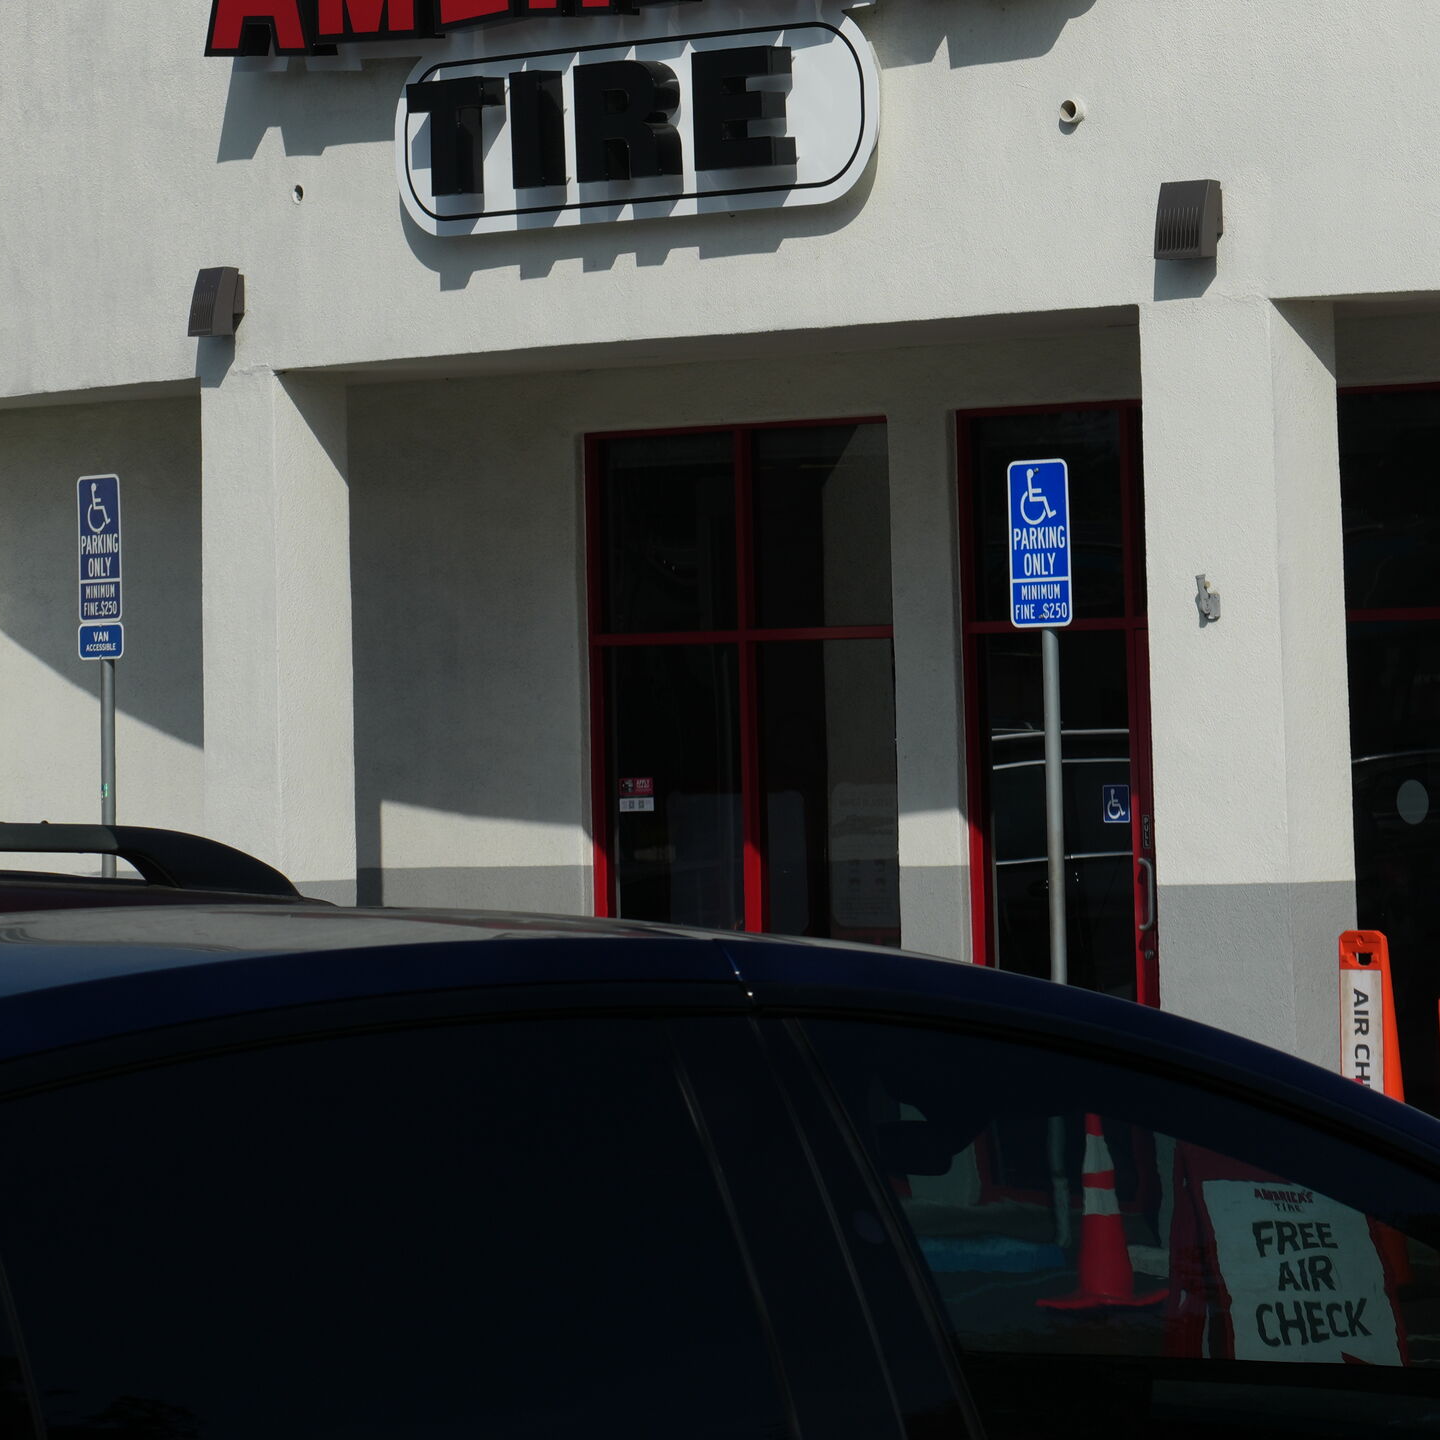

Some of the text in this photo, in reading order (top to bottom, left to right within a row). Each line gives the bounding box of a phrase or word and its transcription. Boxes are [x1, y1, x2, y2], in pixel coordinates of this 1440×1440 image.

[407, 46, 797, 196] TIRE
[81, 533, 119, 555] PARKING
[1013, 525, 1065, 550] PARKING
[88, 557, 112, 578] ONLY
[1024, 553, 1056, 576] ONLY
[85, 583, 115, 598] MINIMUM
[1021, 584, 1061, 600] MINIMUM
[83, 601, 118, 617] FINE $250
[1015, 602, 1068, 620] FINE $250
[86, 643, 116, 652] ACCESSIBLE
[93, 631, 109, 643] VAN
[1353, 988, 1371, 1089] AIR CH
[1252, 1220, 1339, 1258] FREE
[1278, 1255, 1336, 1291] AIR
[1255, 1297, 1372, 1347] CHECK
